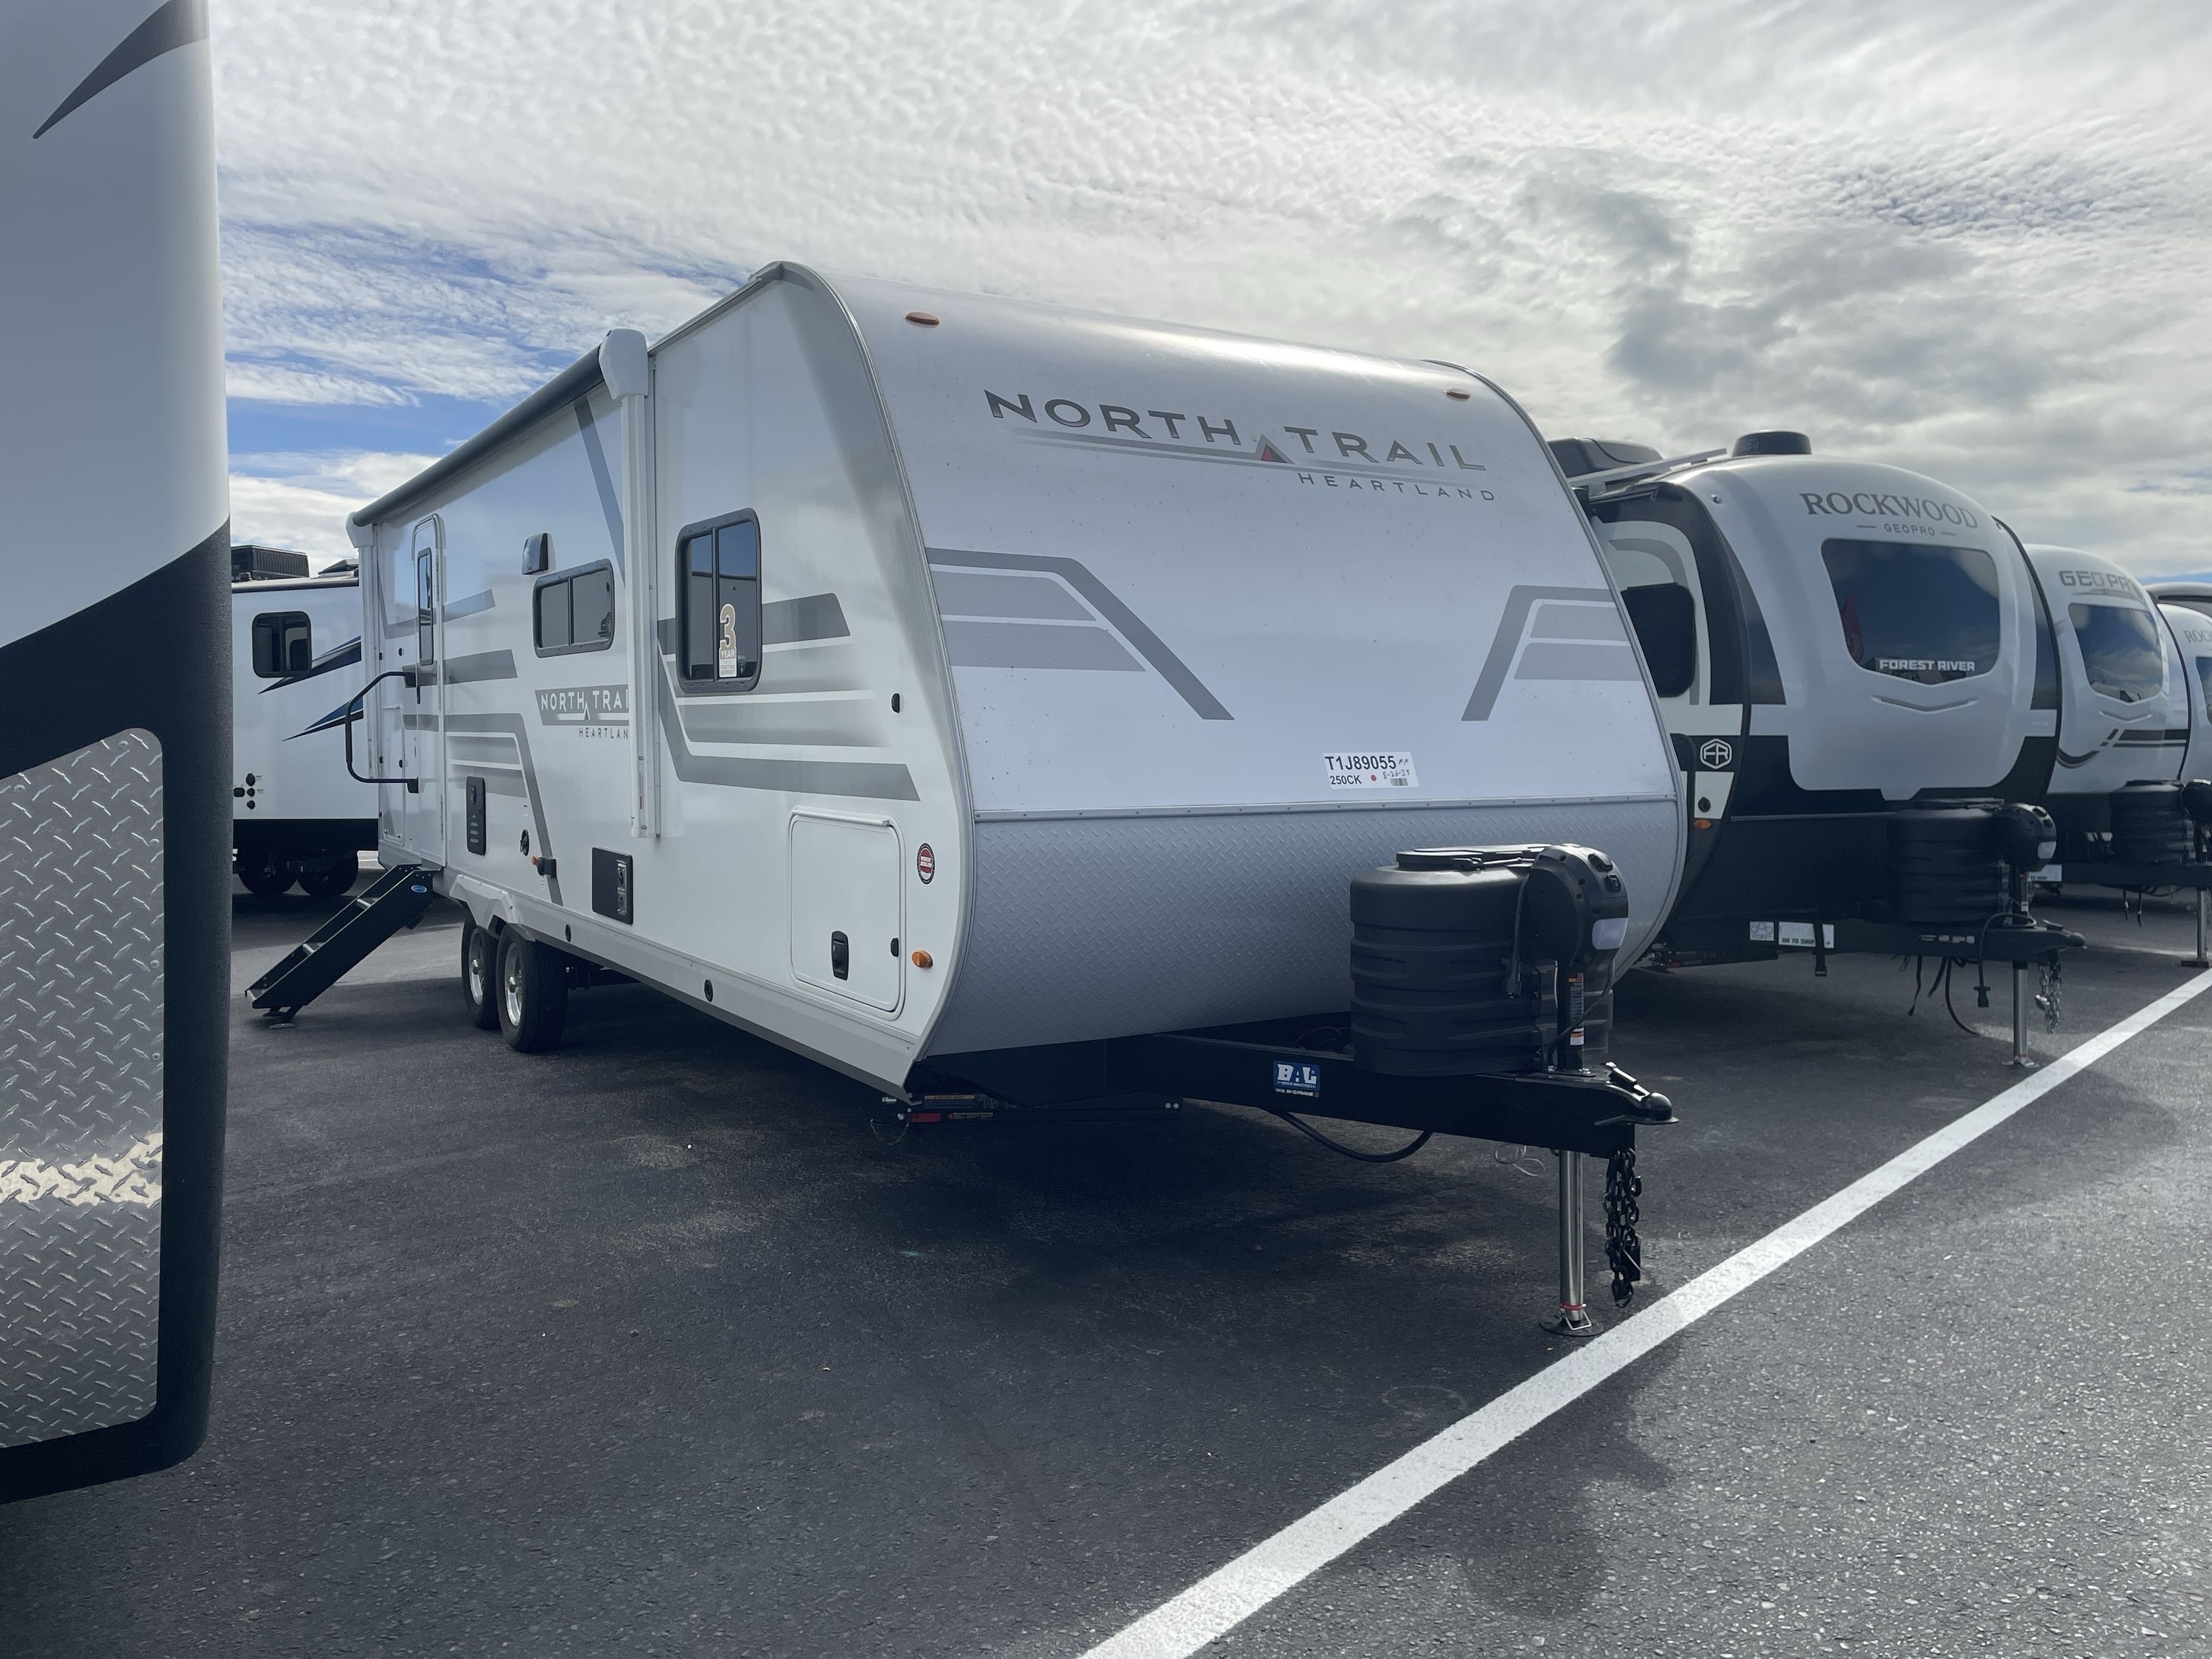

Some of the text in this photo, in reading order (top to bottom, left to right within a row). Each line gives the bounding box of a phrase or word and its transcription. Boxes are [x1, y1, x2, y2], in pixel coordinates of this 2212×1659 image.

[984, 389, 1486, 471] NORTH TRAIL
[1298, 473, 1495, 501] HEARTLAND
[1799, 492, 1978, 529] ROCKWOOD
[1884, 523, 1935, 537] GEOPRO
[2059, 571, 2105, 587] GEO
[720, 603, 736, 649] 3
[720, 649, 735, 658] YEAR
[1879, 659, 1975, 672] FOREST RIVER
[540, 689, 629, 712] NORTH TRAI
[579, 727, 628, 740] HEARTLAN
[1324, 755, 1397, 771] T1J89055
[1329, 774, 1363, 785] 250CK
